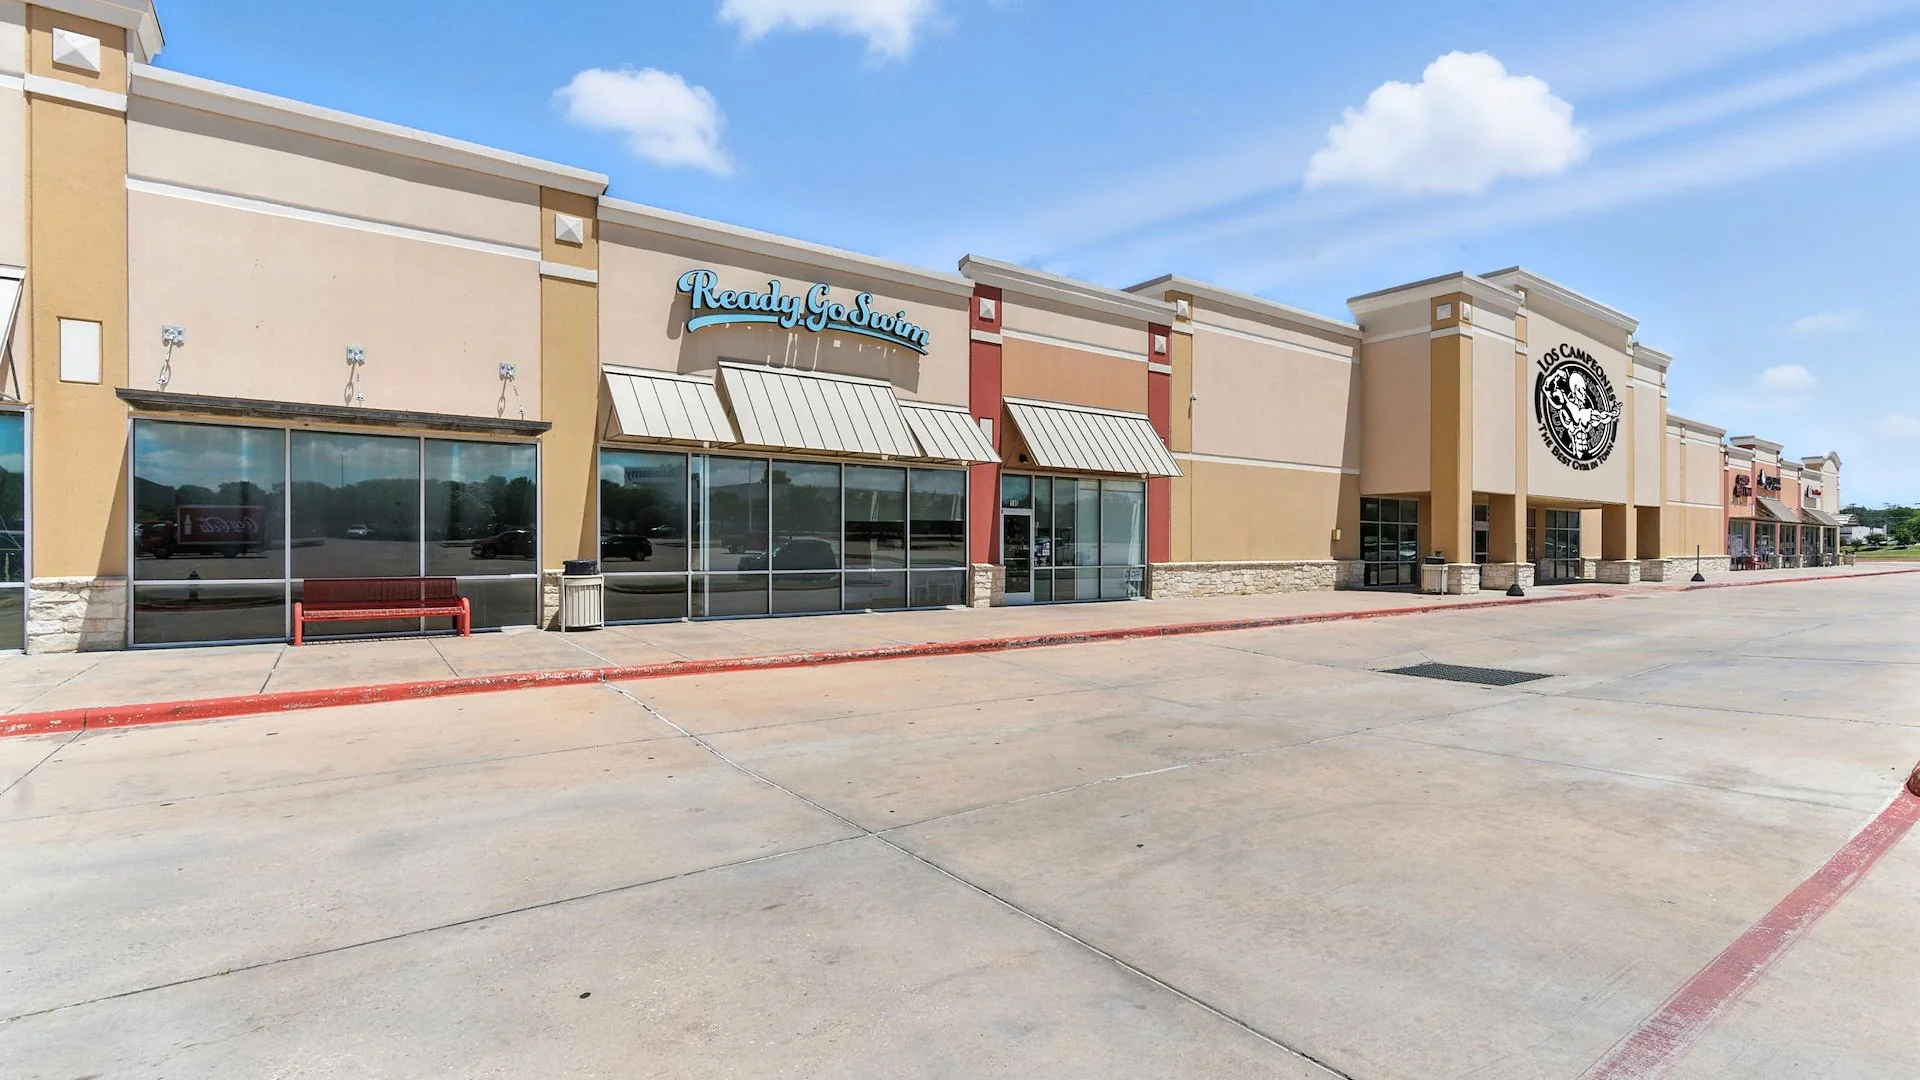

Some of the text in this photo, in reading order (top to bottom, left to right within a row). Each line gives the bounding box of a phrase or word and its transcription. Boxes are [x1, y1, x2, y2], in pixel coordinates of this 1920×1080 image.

[677, 269, 929, 347] Ready Go Swim
[1537, 348, 1560, 373] LOS
[1559, 343, 1617, 402] CAMPEONES
[1538, 423, 1554, 448] THE
[1551, 445, 1572, 467] BEST
[1598, 442, 1615, 464] TOWN
